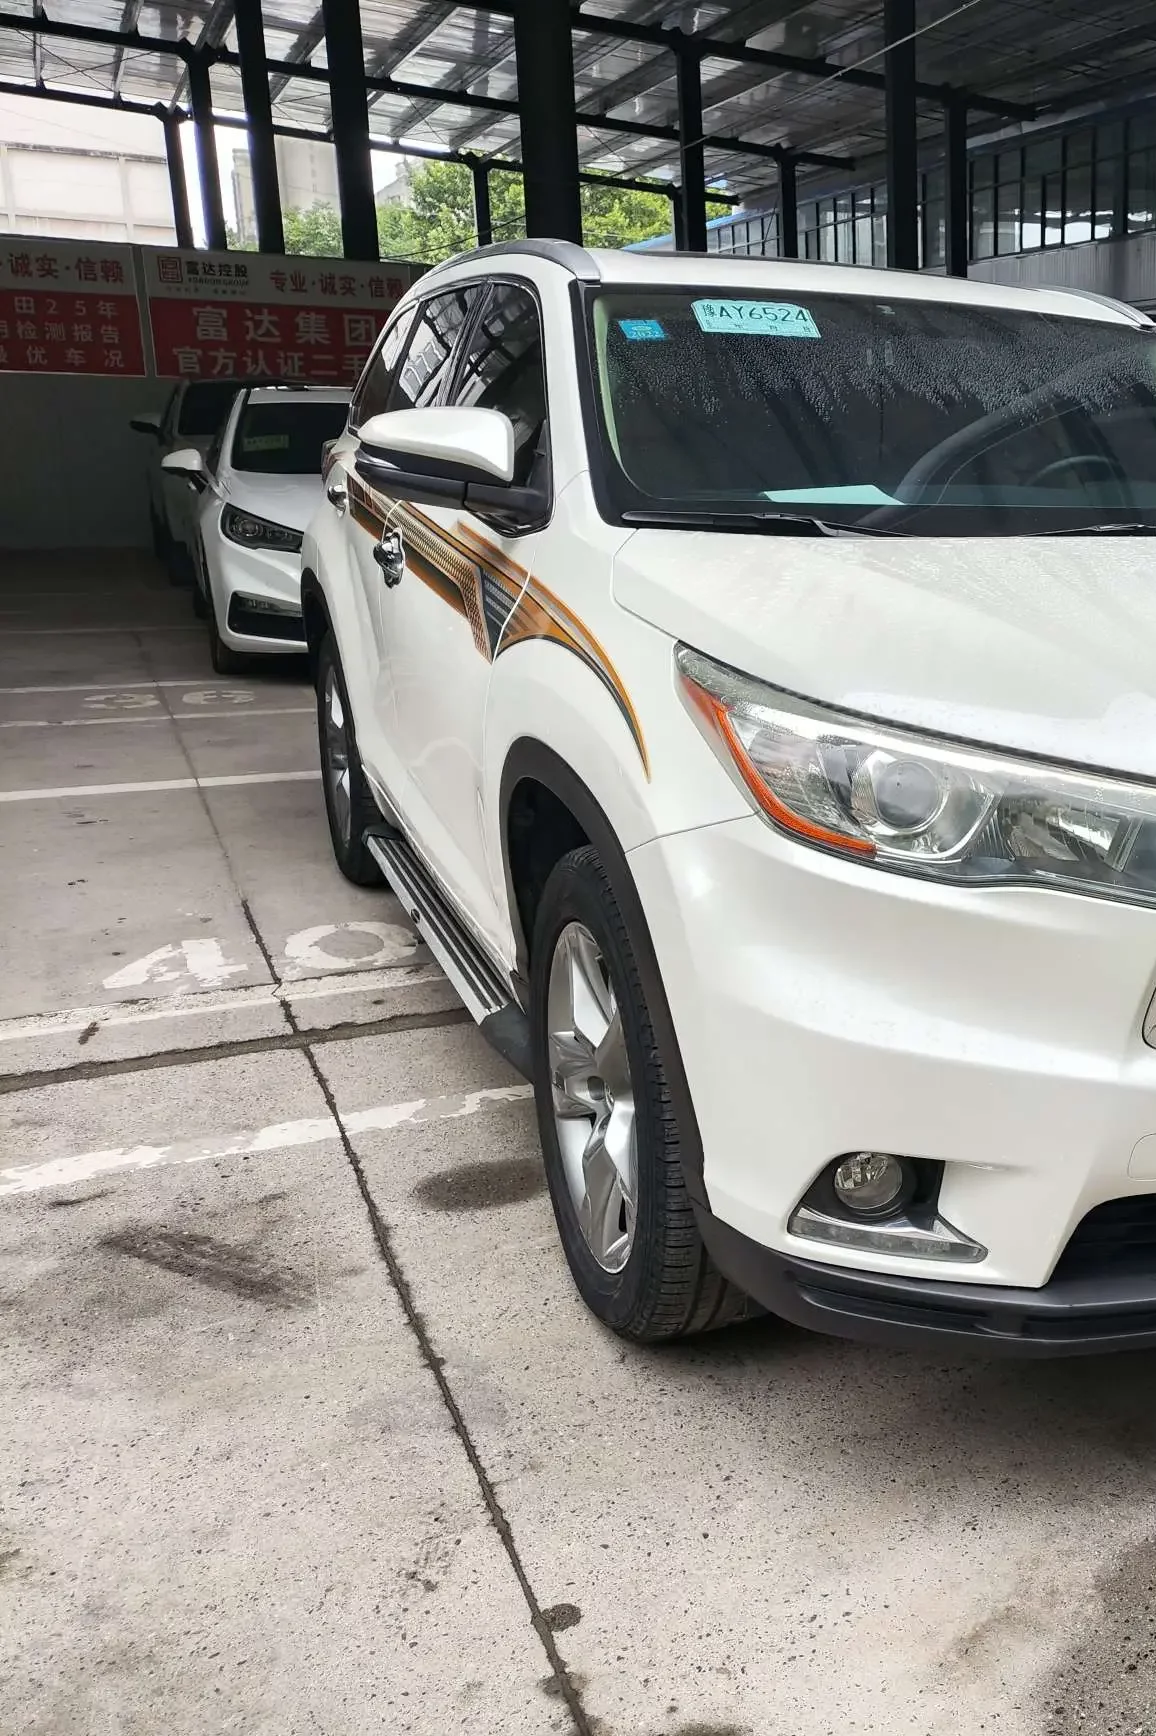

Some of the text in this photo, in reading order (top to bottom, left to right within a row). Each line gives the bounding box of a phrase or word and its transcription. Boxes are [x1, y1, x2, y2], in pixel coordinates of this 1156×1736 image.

[186, 260, 248, 278] 富达控股
[192, 305, 376, 347] 富达集团
[172, 346, 368, 378] 官方认证二手
[103, 921, 417, 990] 40
